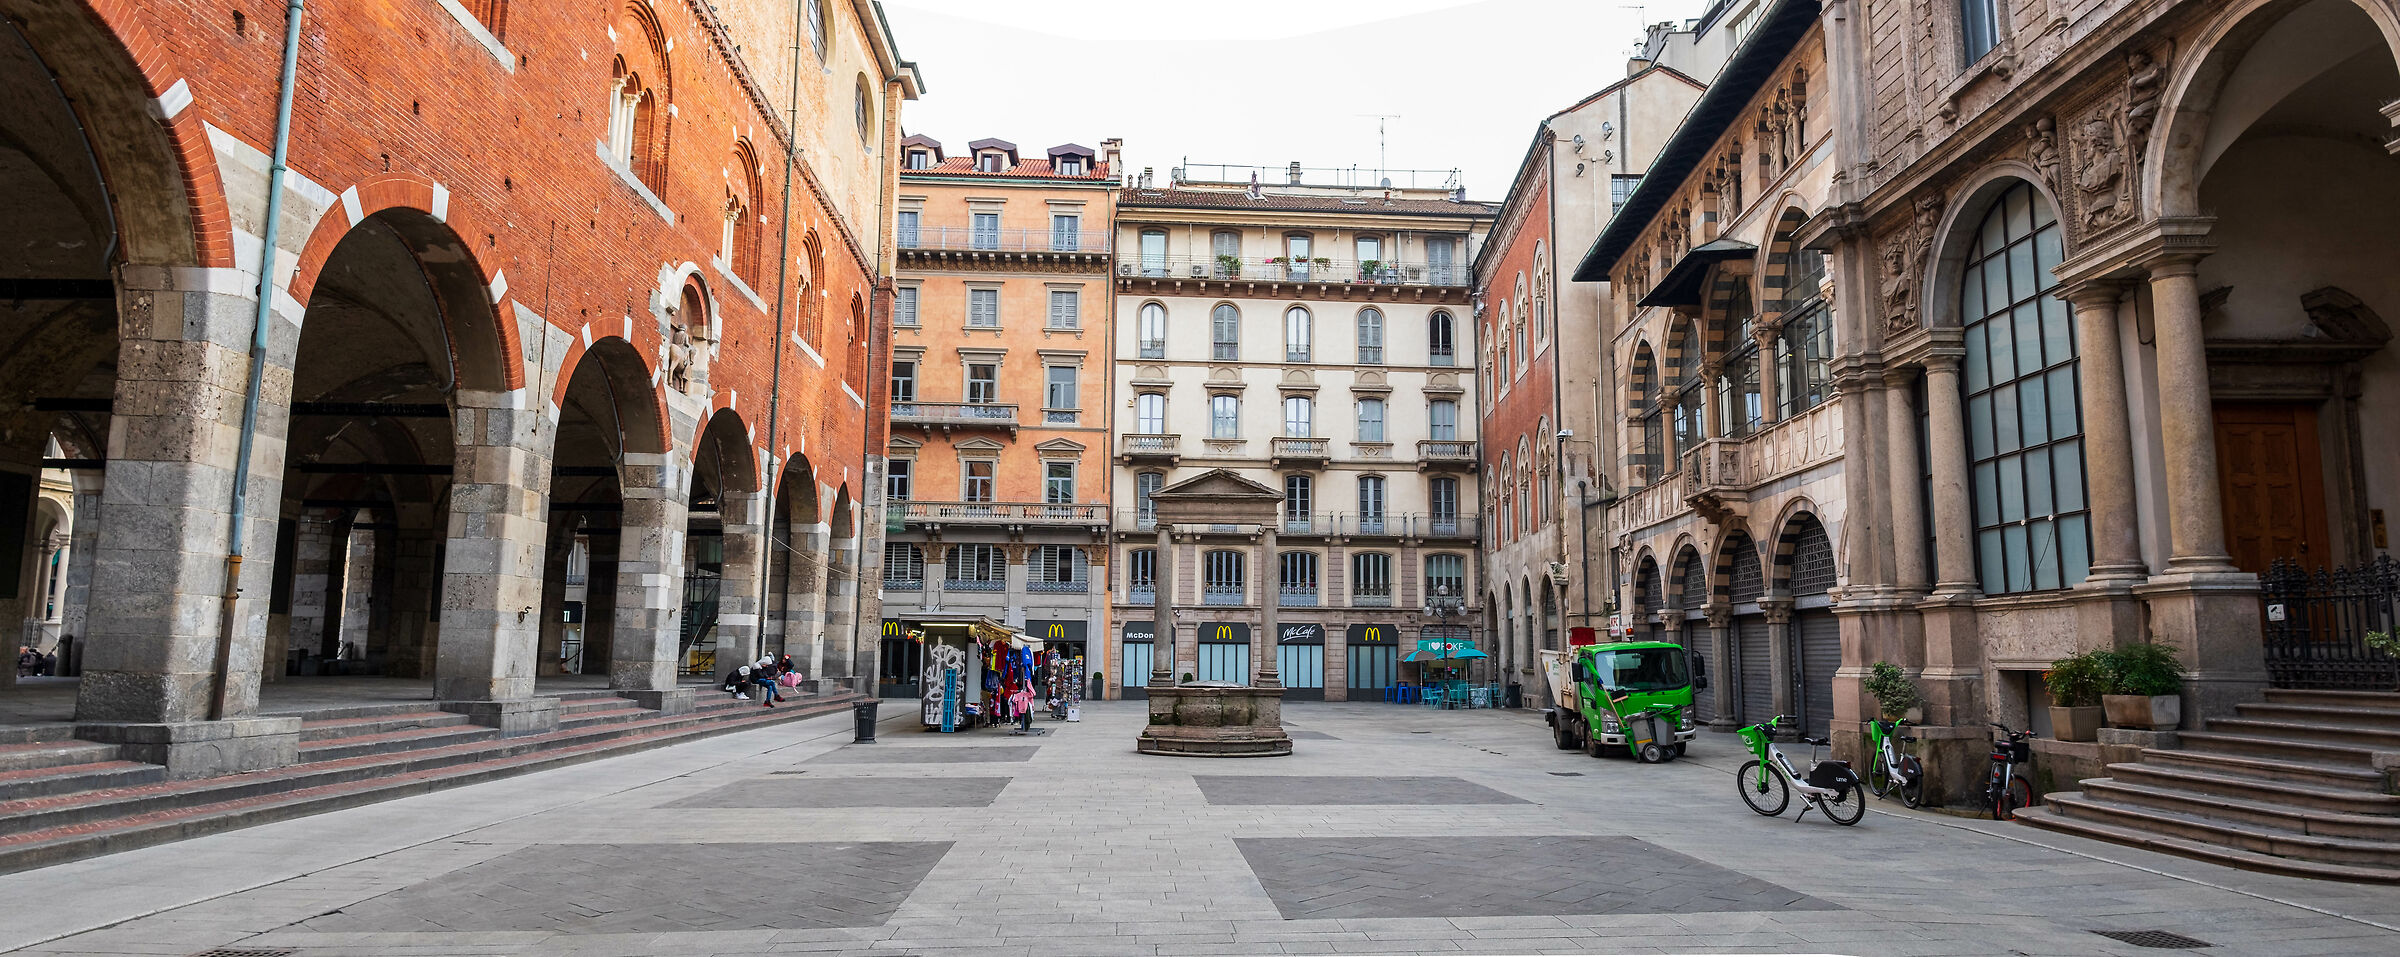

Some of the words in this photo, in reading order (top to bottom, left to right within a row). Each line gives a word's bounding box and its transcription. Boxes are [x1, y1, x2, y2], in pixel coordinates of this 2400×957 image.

[883, 621, 899, 636] M
[1048, 623, 1065, 638] M
[1216, 625, 1233, 640] M
[1364, 627, 1381, 642] M
